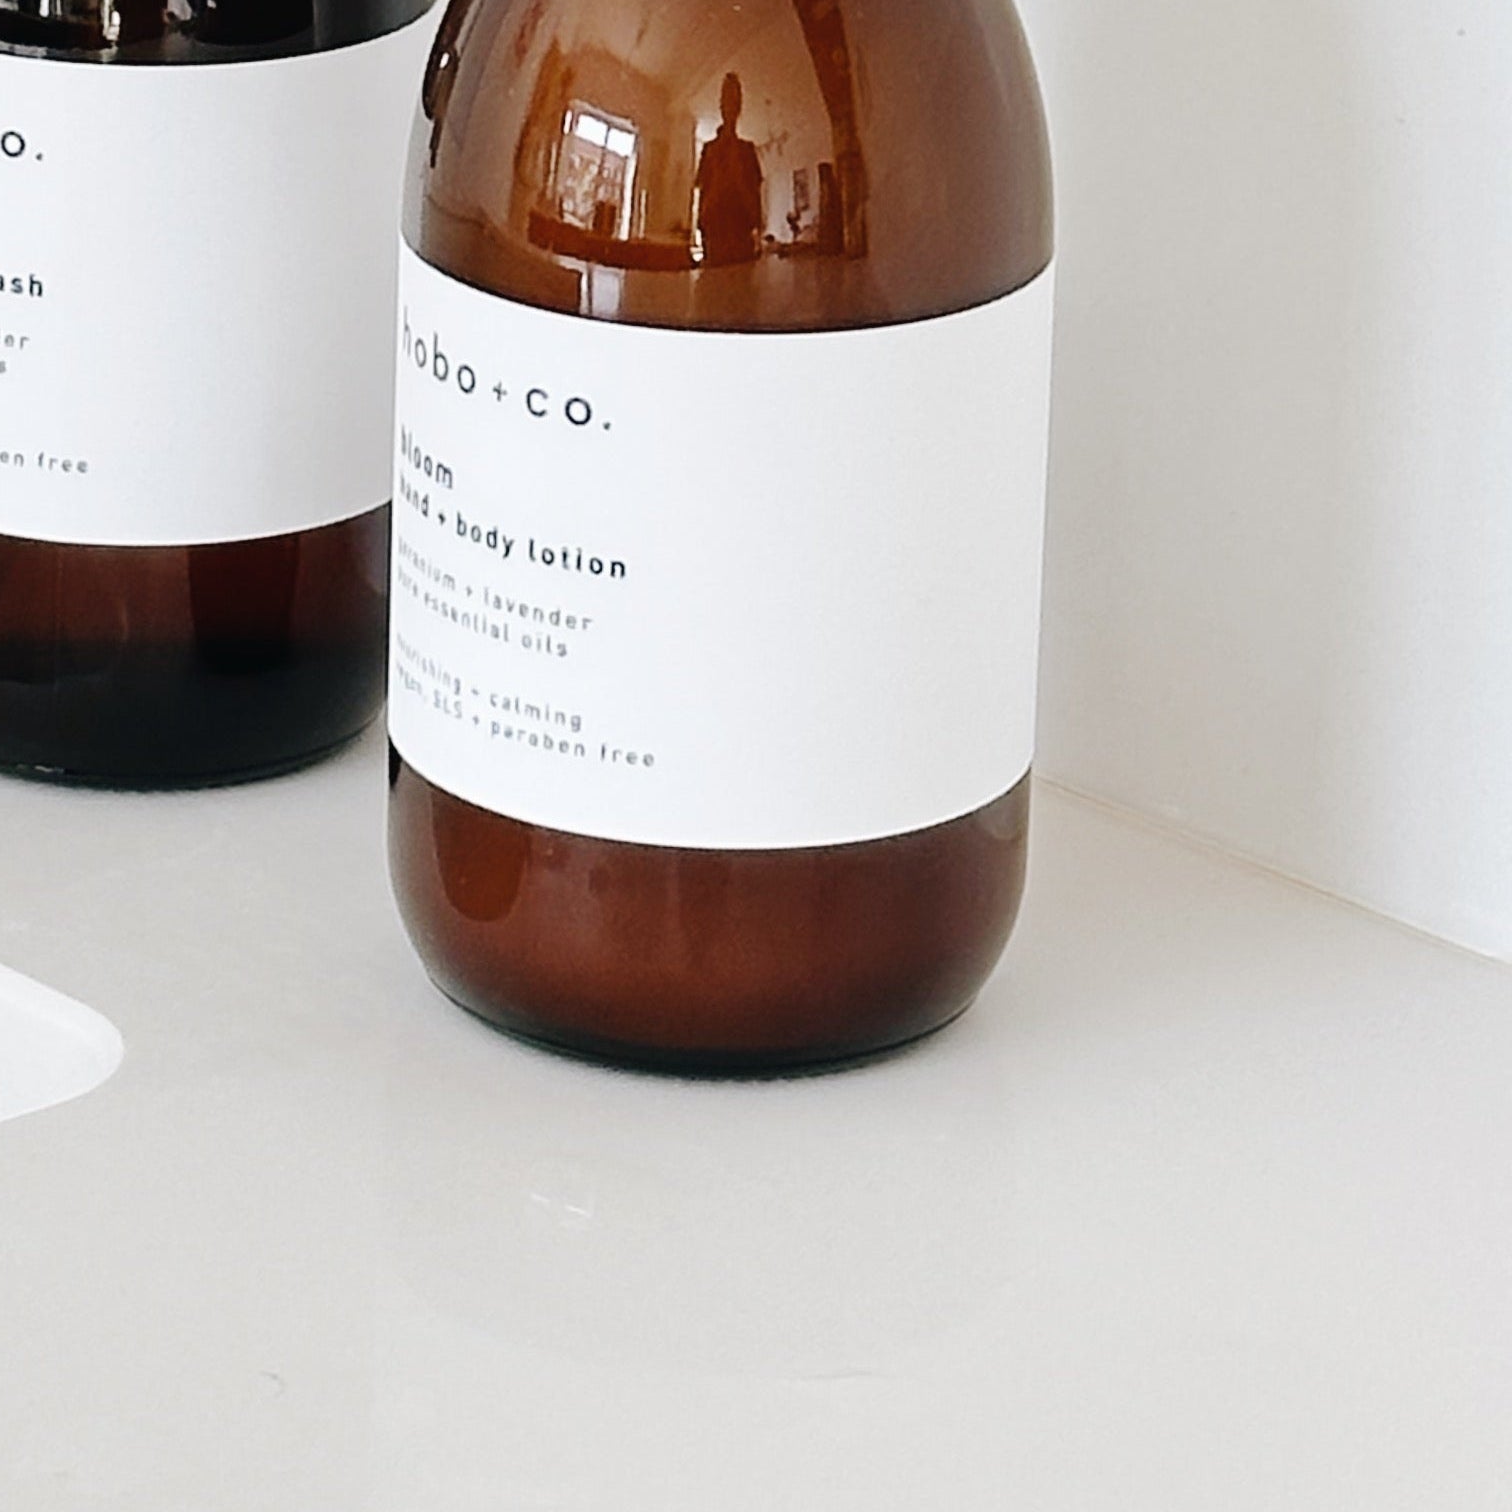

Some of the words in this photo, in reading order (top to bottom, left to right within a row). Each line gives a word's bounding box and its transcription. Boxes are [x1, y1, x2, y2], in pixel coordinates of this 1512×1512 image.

[37, 452, 90, 475] free
[400, 423, 454, 490] bloom
[457, 510, 515, 559] body
[528, 538, 627, 579] lotion
[424, 590, 510, 643] essential
[521, 635, 568, 658] oils
[484, 586, 593, 632] lavender
[489, 691, 583, 733] calming
[490, 719, 586, 758] paraben
[600, 743, 656, 769] free
